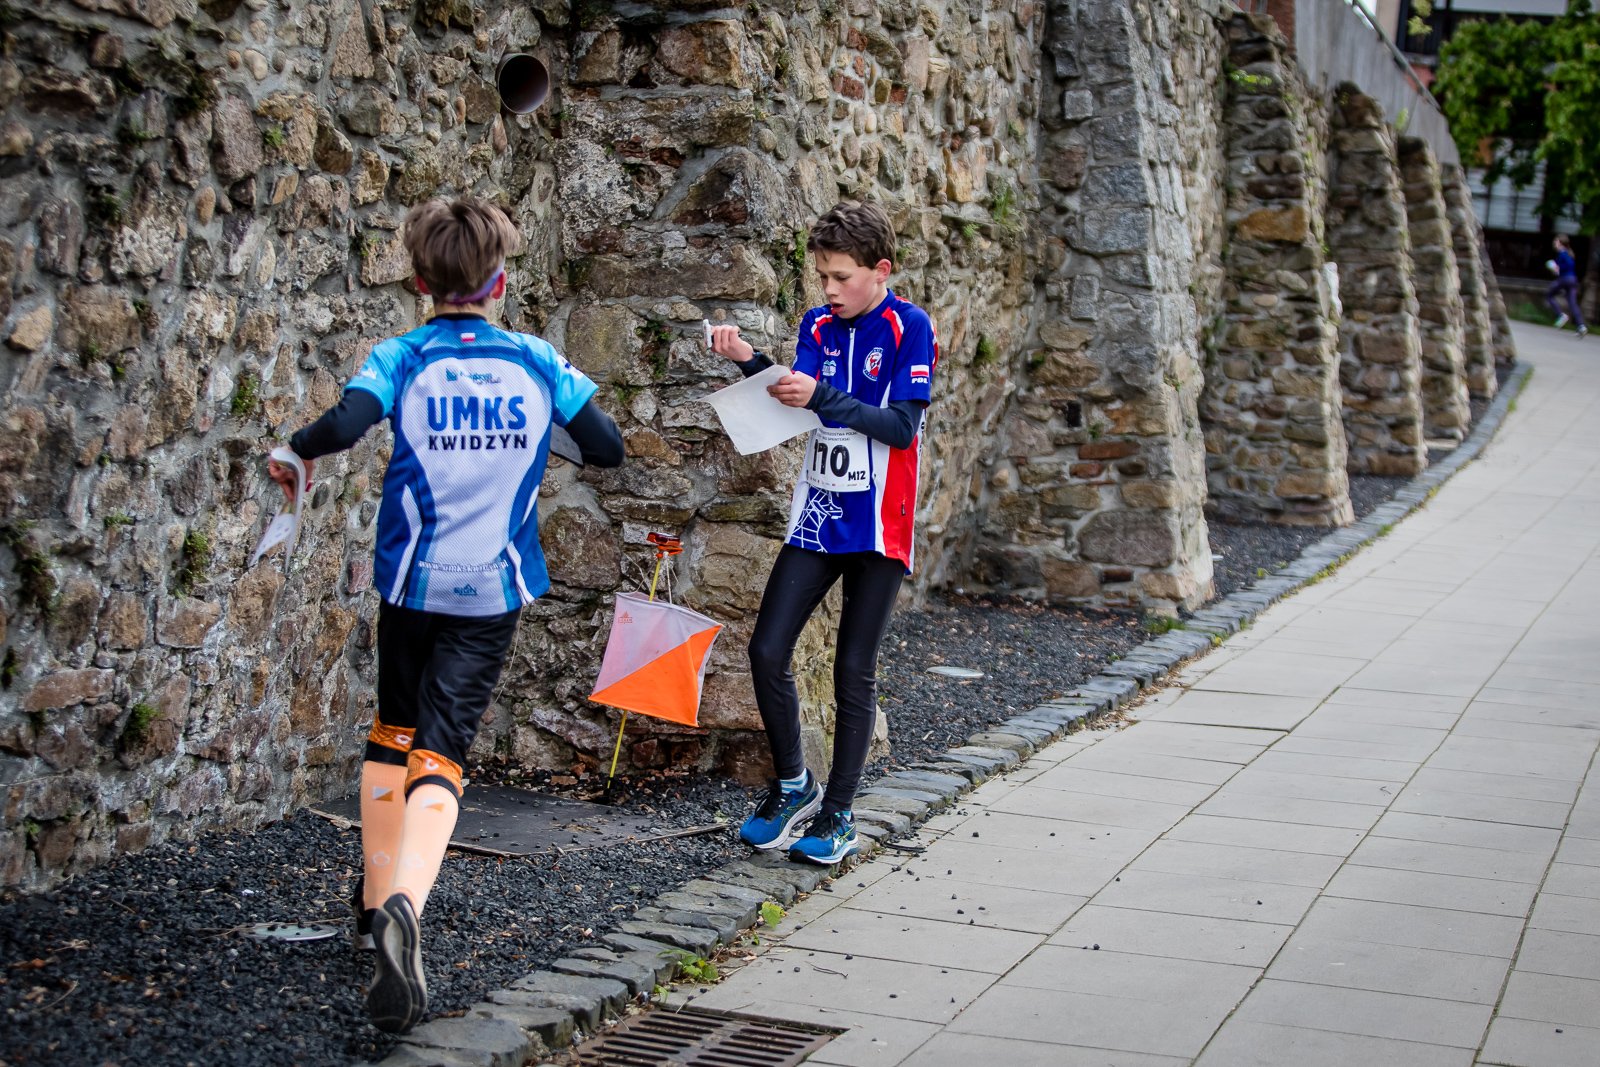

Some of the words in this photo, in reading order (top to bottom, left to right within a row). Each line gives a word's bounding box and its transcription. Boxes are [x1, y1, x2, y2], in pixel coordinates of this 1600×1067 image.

[427, 396, 526, 432] UMKS
[428, 434, 528, 451] KWIDZYN
[848, 470, 866, 481] M12
